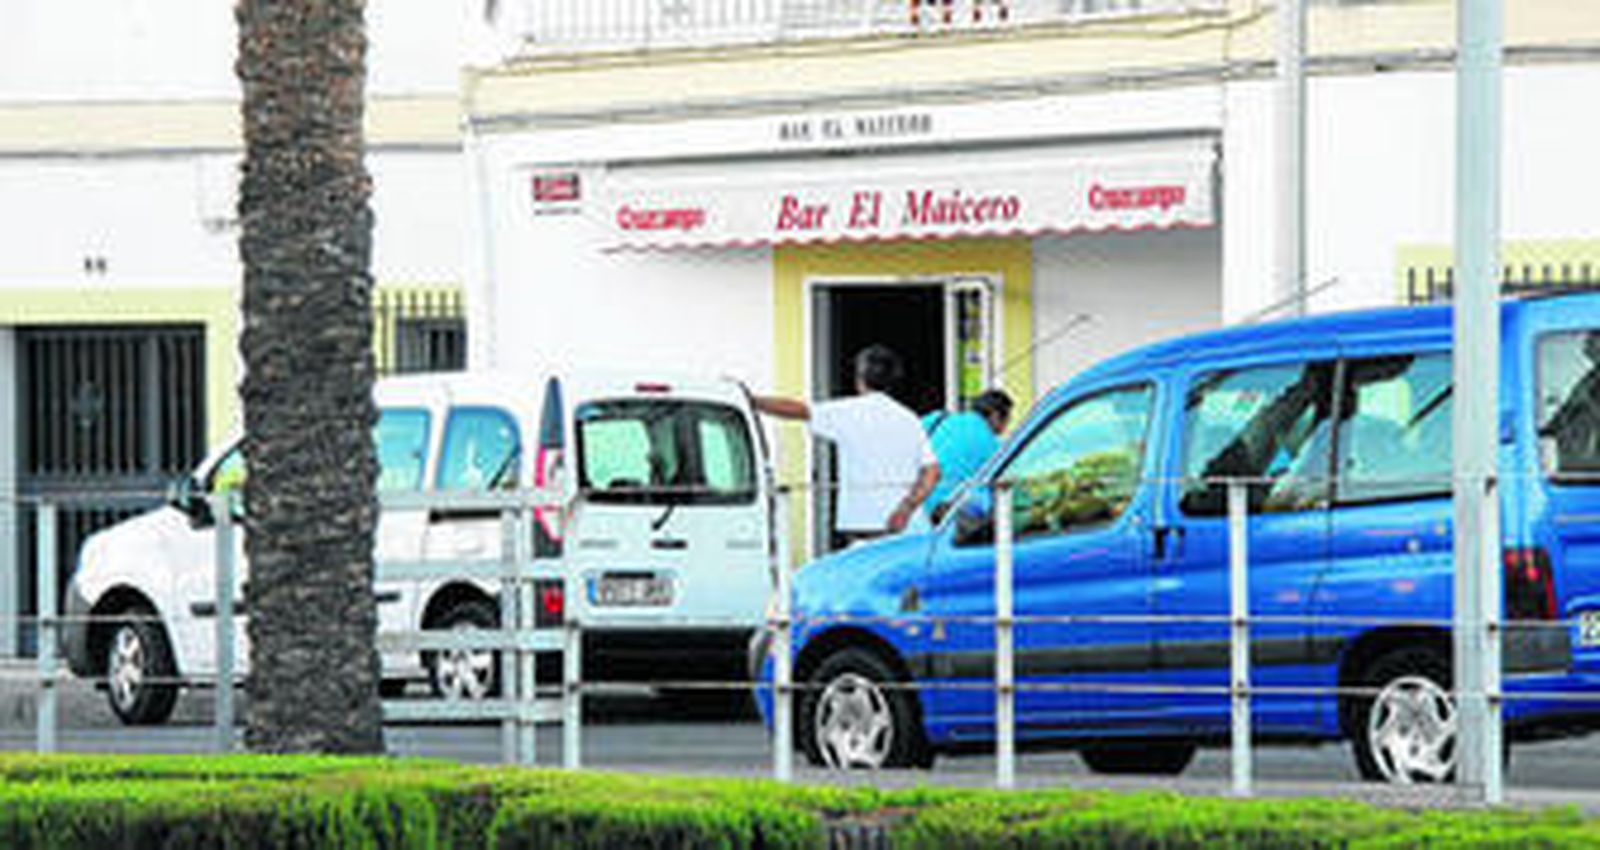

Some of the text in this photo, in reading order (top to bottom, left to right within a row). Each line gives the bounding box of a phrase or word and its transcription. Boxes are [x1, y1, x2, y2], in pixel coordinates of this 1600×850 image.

[776, 189, 1021, 231] Bar El Maicero
